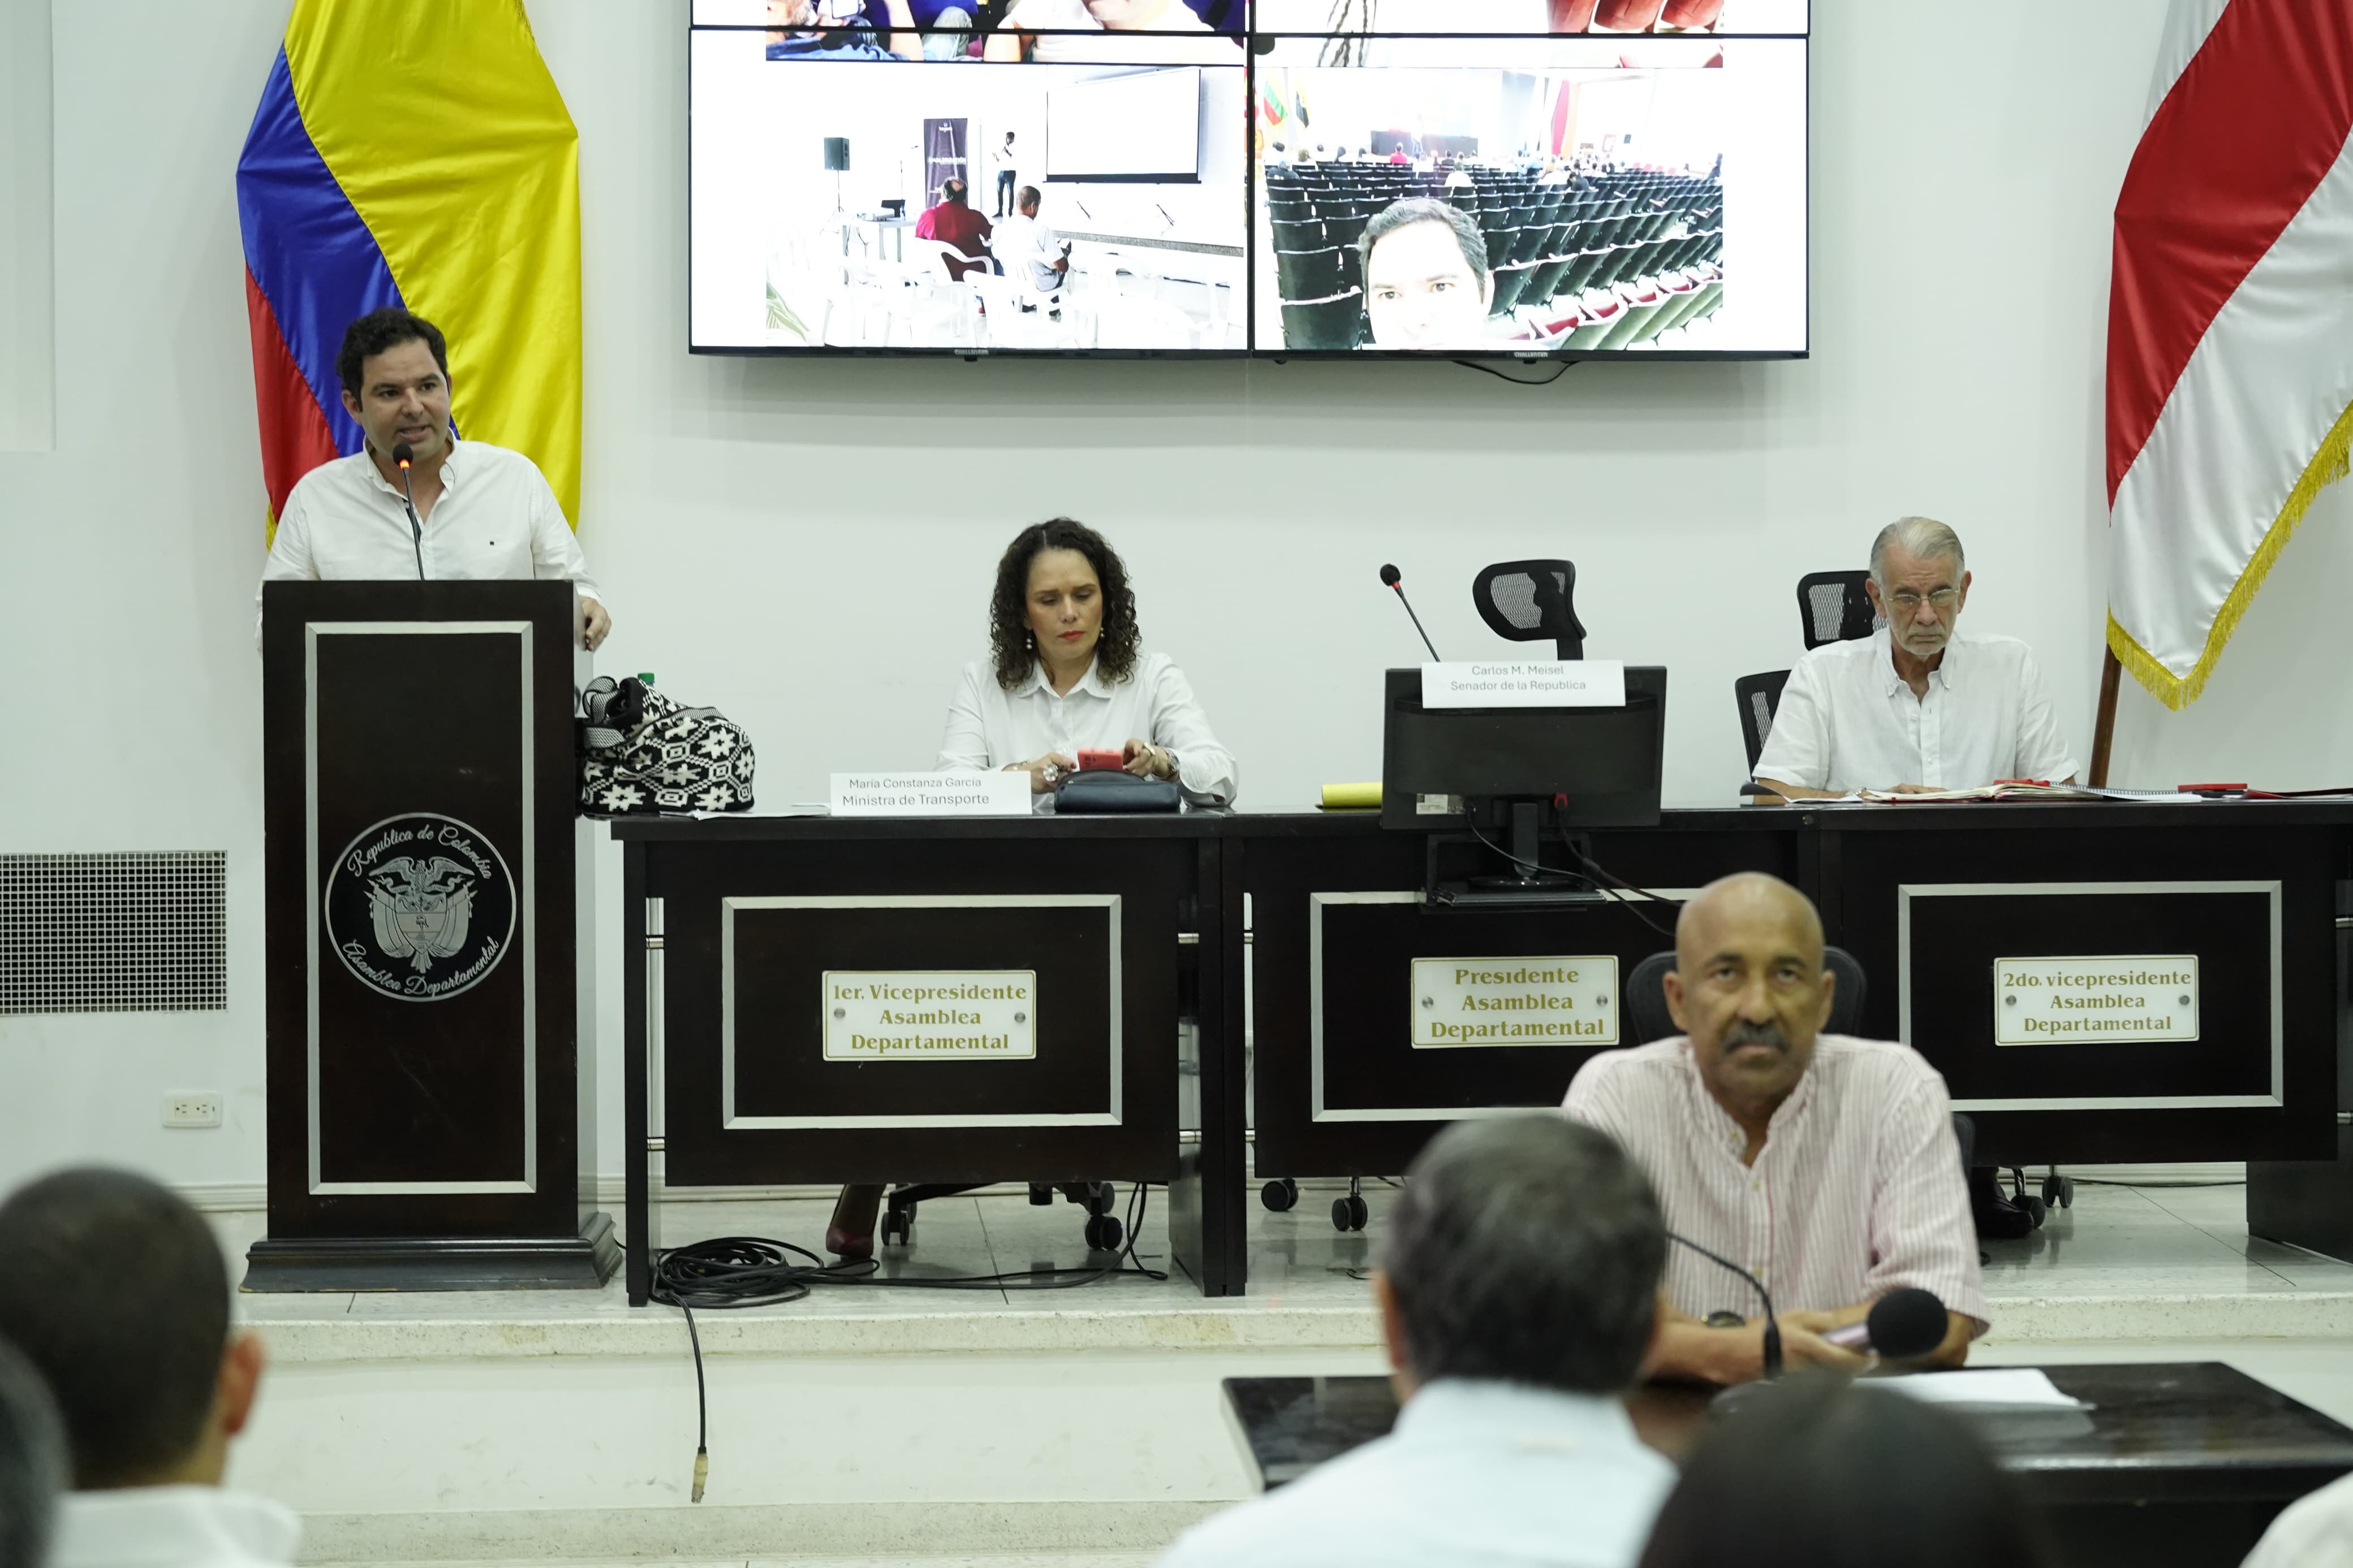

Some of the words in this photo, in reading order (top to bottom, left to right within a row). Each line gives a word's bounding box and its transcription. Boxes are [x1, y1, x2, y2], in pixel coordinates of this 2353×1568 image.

[1472, 666, 1509, 676] Carlos
[1511, 666, 1525, 675] M.
[1528, 665, 1564, 675] Meisel
[1451, 681, 1497, 691] Senador
[1501, 681, 1514, 690] de
[1518, 681, 1527, 690] la
[1530, 680, 1586, 691] Republica
[883, 777, 942, 788] Constanza
[945, 777, 981, 788] García
[842, 794, 895, 806] Ministra
[899, 794, 915, 805] de
[919, 793, 989, 807] Transporte
[347, 828, 413, 878] Republica
[417, 824, 434, 840] de
[438, 824, 492, 879] Colombia
[342, 939, 402, 991] Asamblea
[404, 935, 499, 997] Departamental
[1455, 967, 1579, 985] Presidente
[2003, 973, 2042, 987] 2do.
[2046, 970, 2191, 990] vicepresidente
[869, 983, 1027, 1004] Vicepresidente
[1462, 994, 1573, 1011] Asamblea
[2050, 995, 2145, 1009] Asamblea
[880, 1009, 981, 1025] Asamblea
[2024, 1016, 2171, 1035] Departamental
[1430, 1019, 1604, 1042] Departamental
[851, 1034, 1009, 1053] Departamental
